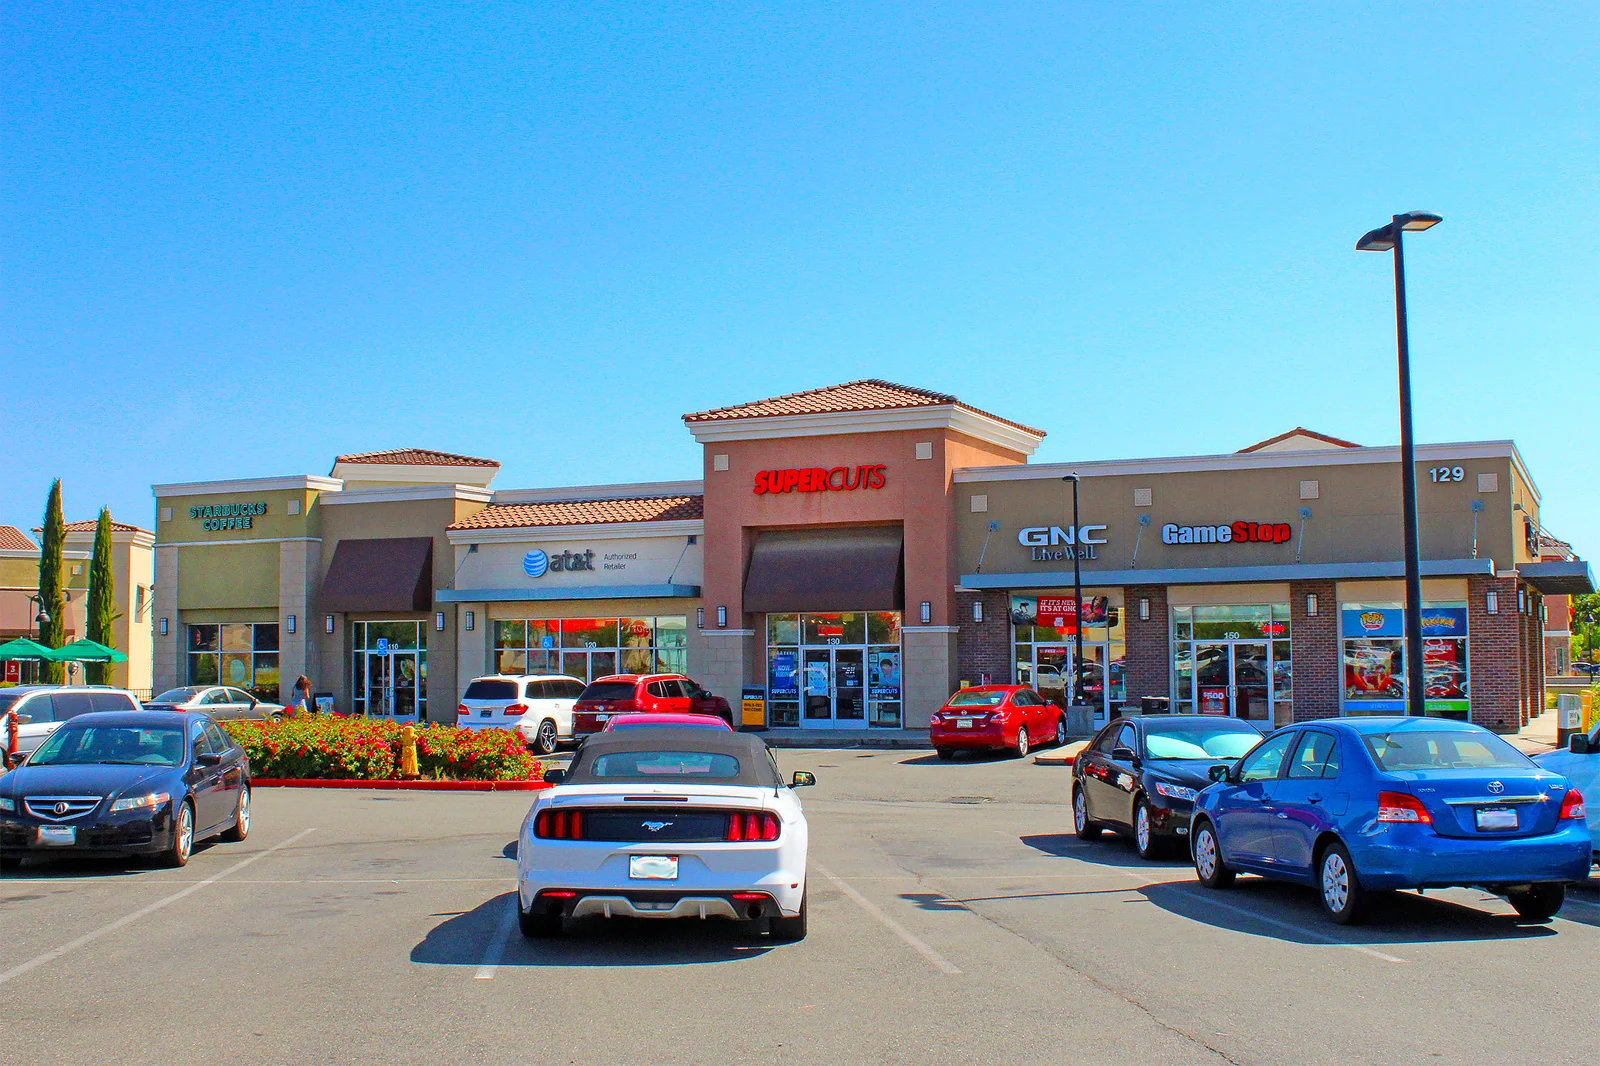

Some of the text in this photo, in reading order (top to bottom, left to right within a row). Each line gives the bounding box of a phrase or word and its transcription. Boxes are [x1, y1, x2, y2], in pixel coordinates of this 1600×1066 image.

[753, 463, 887, 495] SUPERCUTS
[1429, 466, 1465, 483] 129
[189, 501, 267, 519] STARBUCKS
[202, 516, 252, 531] COFFEE
[1018, 525, 1108, 547] GNC
[1161, 520, 1292, 545] GameStop
[549, 548, 596, 572] at&t
[604, 553, 637, 561] Authorized
[1031, 546, 1063, 561] Live
[604, 563, 626, 571] Retailer
[826, 637, 840, 645] 130
[1224, 631, 1240, 640] 150
[584, 641, 597, 649] 120
